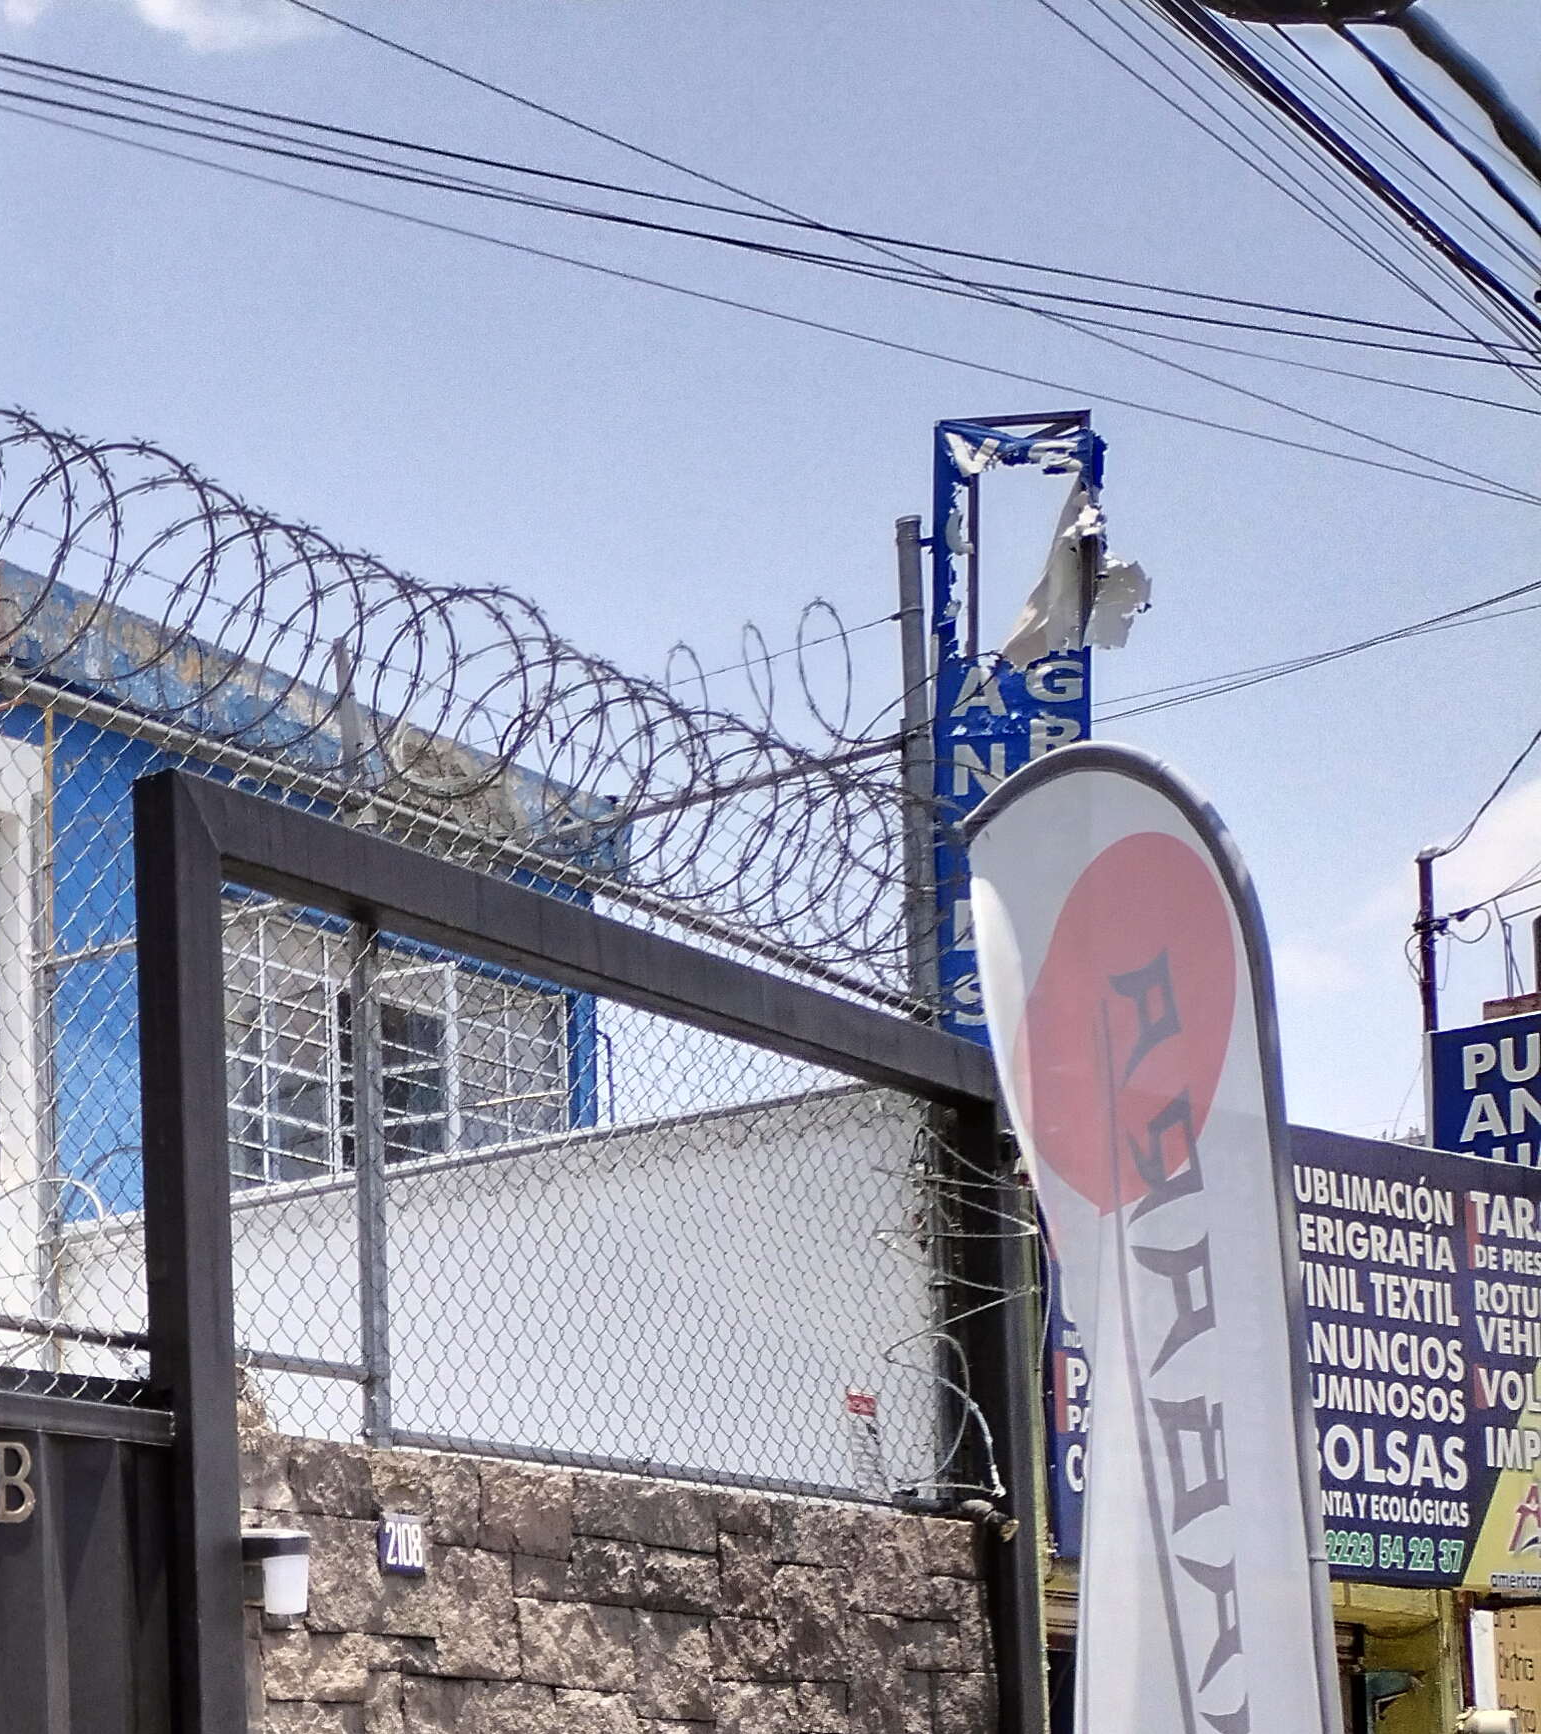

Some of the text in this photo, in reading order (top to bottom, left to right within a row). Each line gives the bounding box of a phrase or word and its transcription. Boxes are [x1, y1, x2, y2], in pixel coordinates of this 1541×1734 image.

[1297, 1212, 1457, 1273] ERIGRAFÍA
[1474, 1244, 1498, 1271] DE
[1369, 1271, 1460, 1327] TEXTIL
[1475, 1279, 1541, 1319] ROTU
[1356, 1492, 1367, 1519] Y
[1371, 1490, 1469, 1528] ECOLÓGICAS
[385, 1521, 423, 1568] 2108
[1379, 1534, 1405, 1569] 54
[1408, 1537, 1435, 1571] 22
[1439, 1538, 1465, 1574] 37
